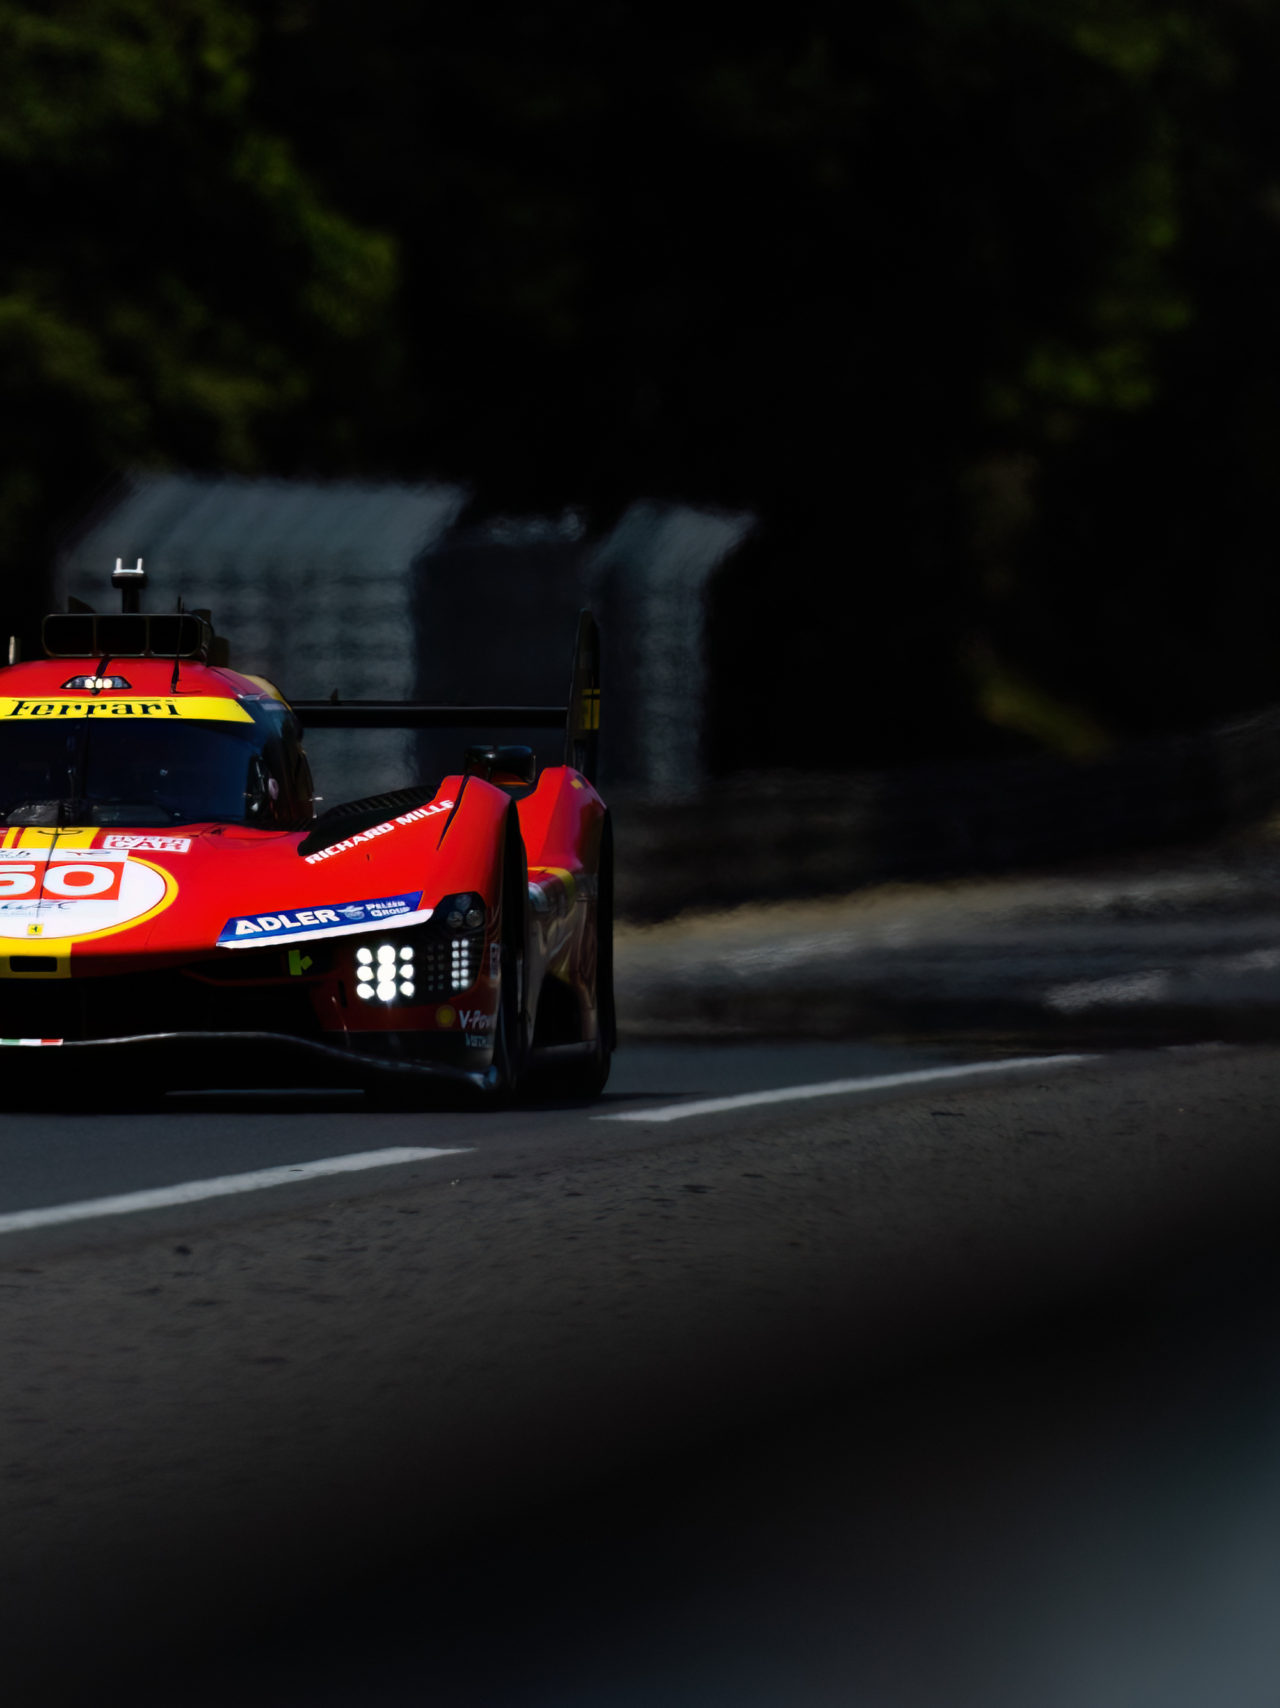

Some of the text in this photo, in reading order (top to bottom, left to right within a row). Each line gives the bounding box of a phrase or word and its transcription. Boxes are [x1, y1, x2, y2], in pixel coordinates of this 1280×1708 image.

[5, 699, 182, 717] Ferrari
[304, 800, 455, 864] RICHARD MILLE
[235, 909, 340, 935] ADLER
